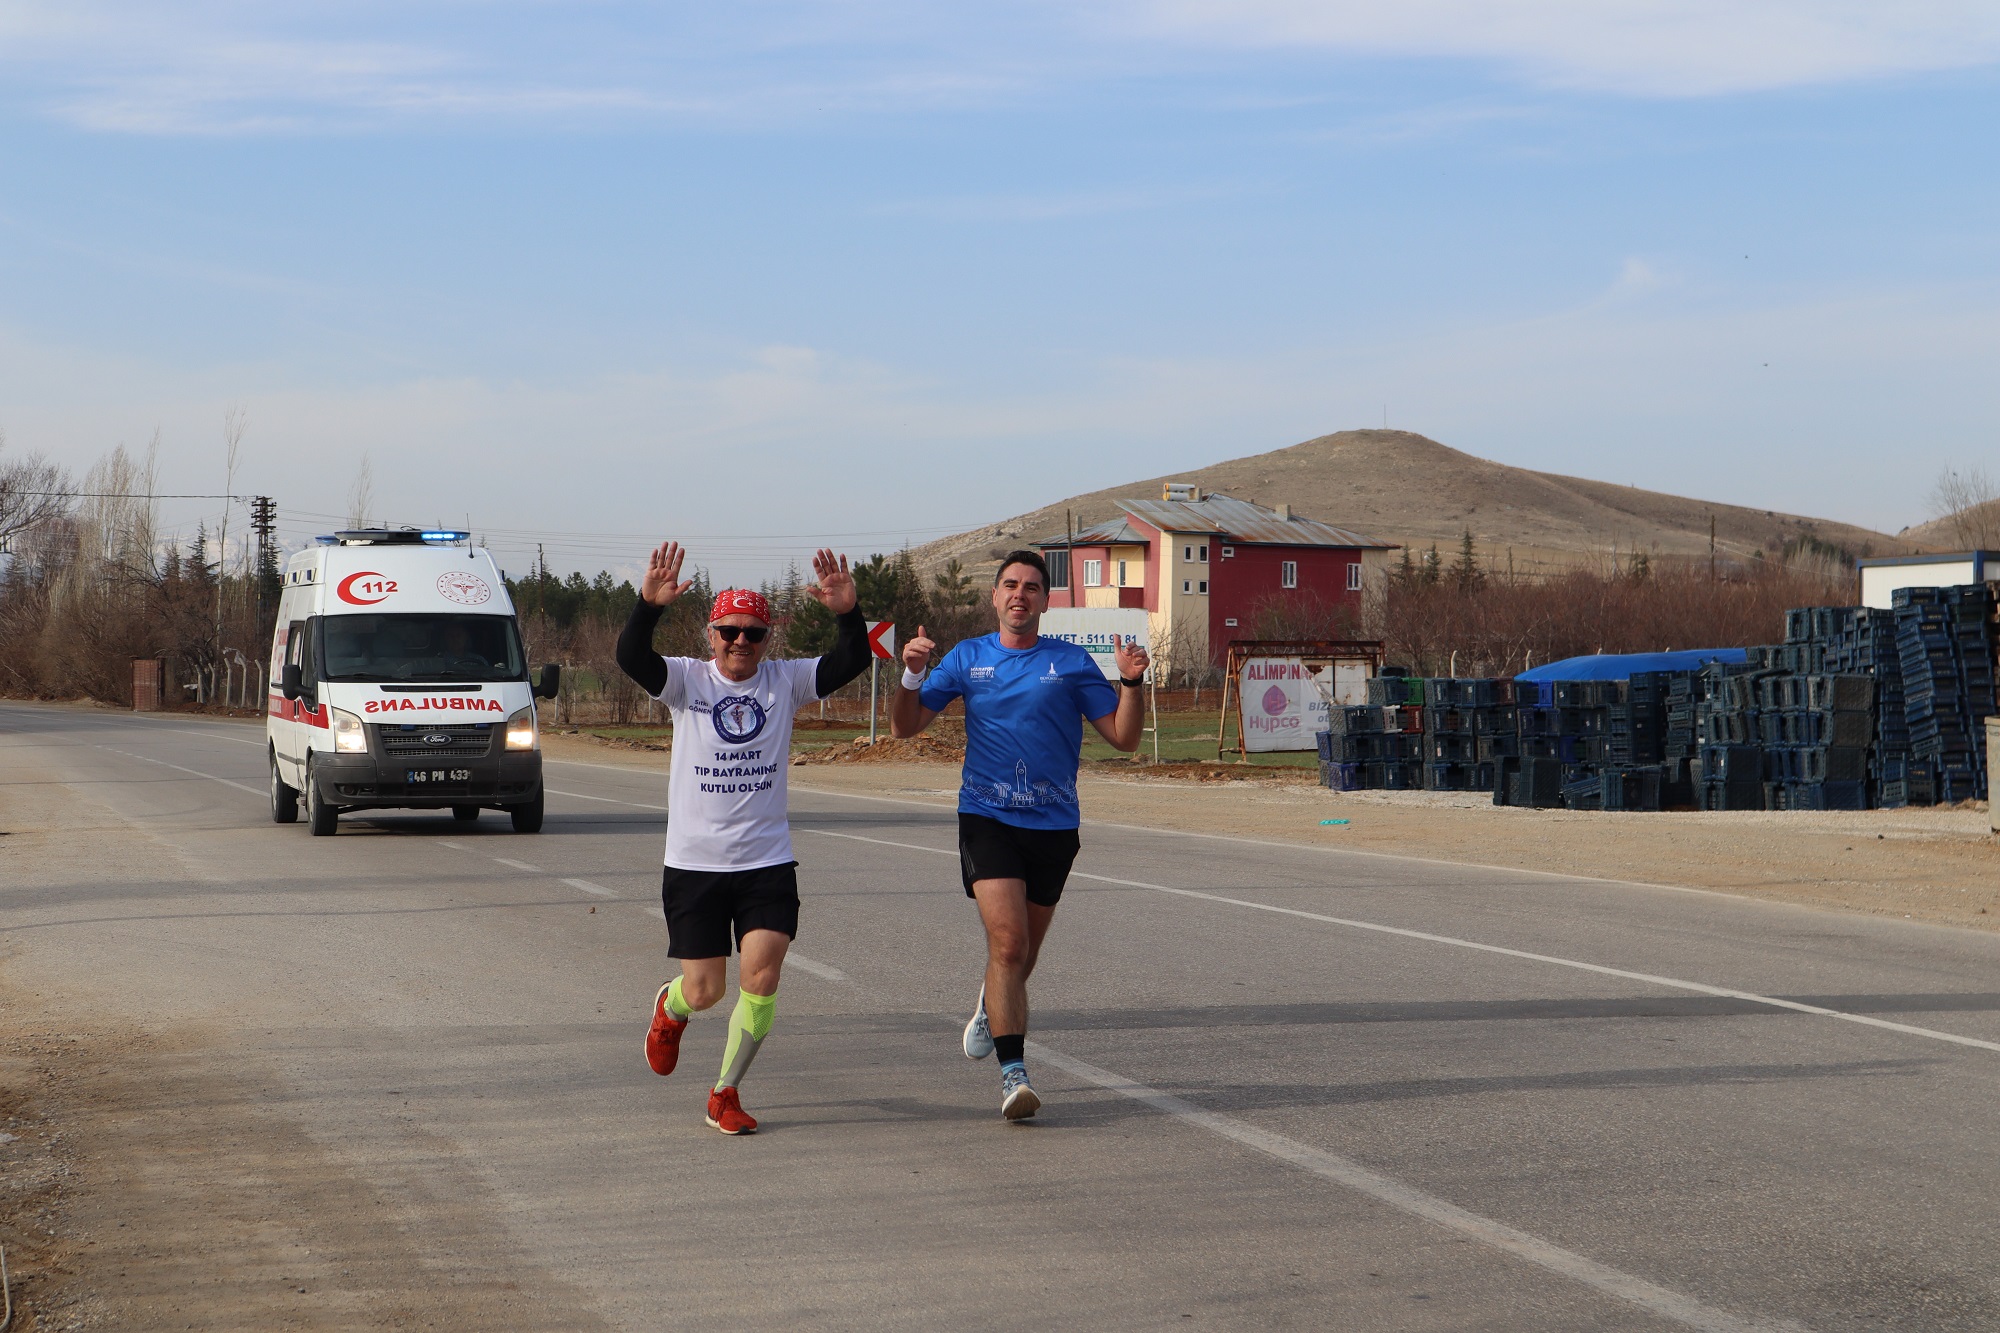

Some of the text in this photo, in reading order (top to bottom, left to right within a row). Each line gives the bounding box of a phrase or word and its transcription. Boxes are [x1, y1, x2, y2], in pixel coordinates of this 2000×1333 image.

[362, 581, 398, 593] 112
[1087, 634, 1105, 644] 511
[1125, 634, 1136, 644] 81
[688, 705, 713, 715] GÖNEN
[1249, 715, 1300, 733] Hypco
[430, 735, 446, 743] Ford
[714, 750, 762, 761] 14 MART
[414, 771, 427, 782] 46
[450, 769, 469, 780] 433
[694, 763, 778, 777] TIP BAYRAMINIZ
[700, 780, 773, 794] KUTLU OLSUN
